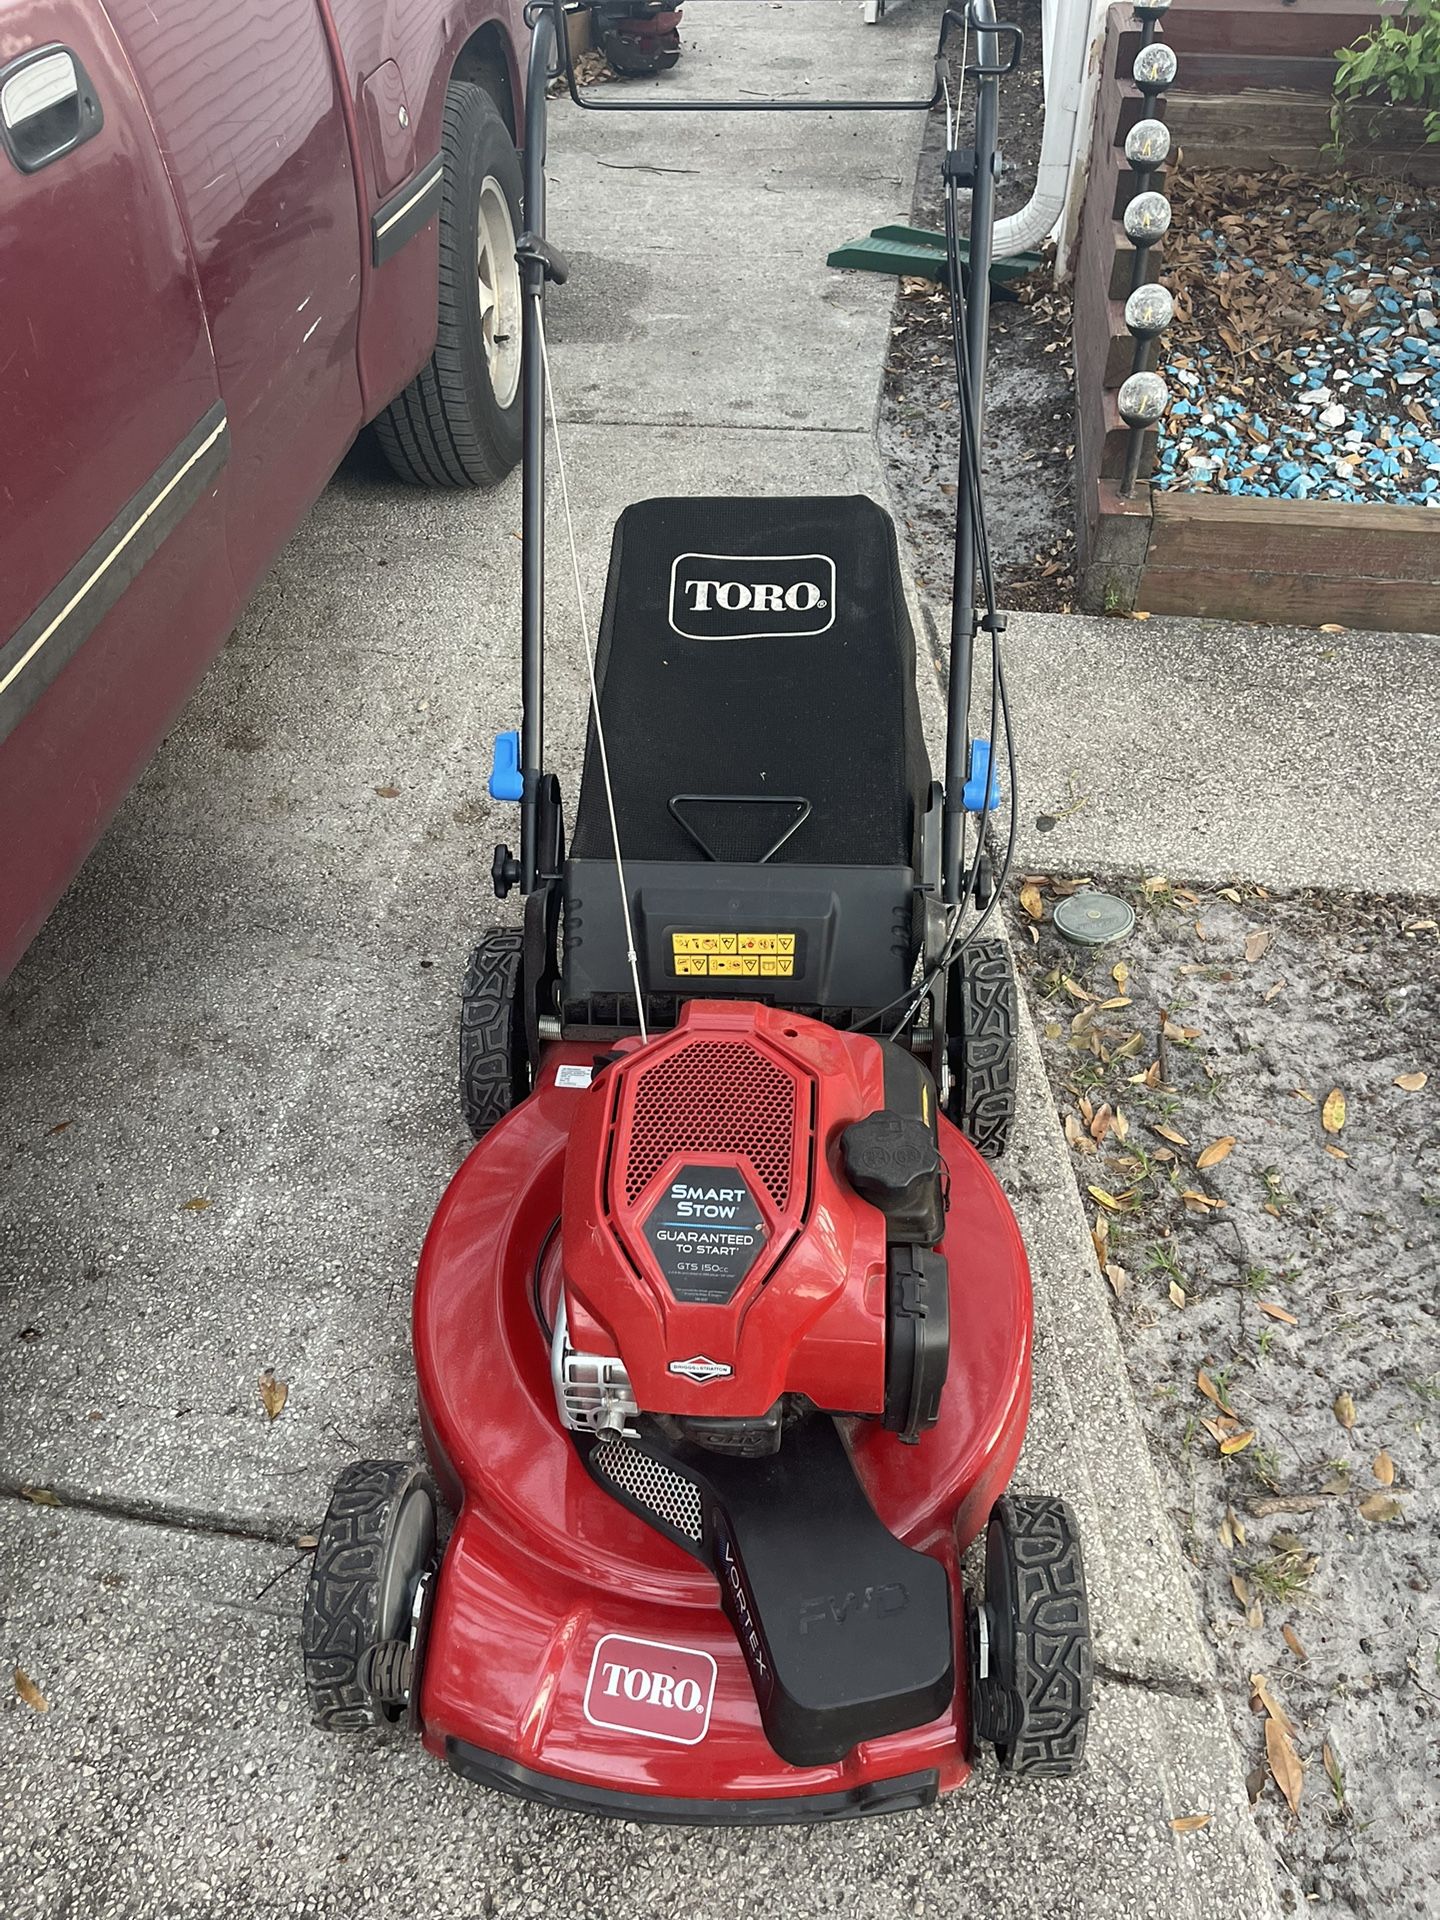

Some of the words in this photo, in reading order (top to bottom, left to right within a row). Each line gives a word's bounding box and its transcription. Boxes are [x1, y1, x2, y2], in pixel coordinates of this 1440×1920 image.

[685, 580, 821, 612] TORO
[671, 1184, 745, 1202] SMART
[676, 1201, 736, 1219] STOW
[656, 1230, 754, 1246] GUARANTEED
[676, 1244, 693, 1253] TO
[677, 1262, 698, 1271] GTS
[724, 1541, 767, 1676] VORTEX
[601, 1662, 702, 1712] TORO
